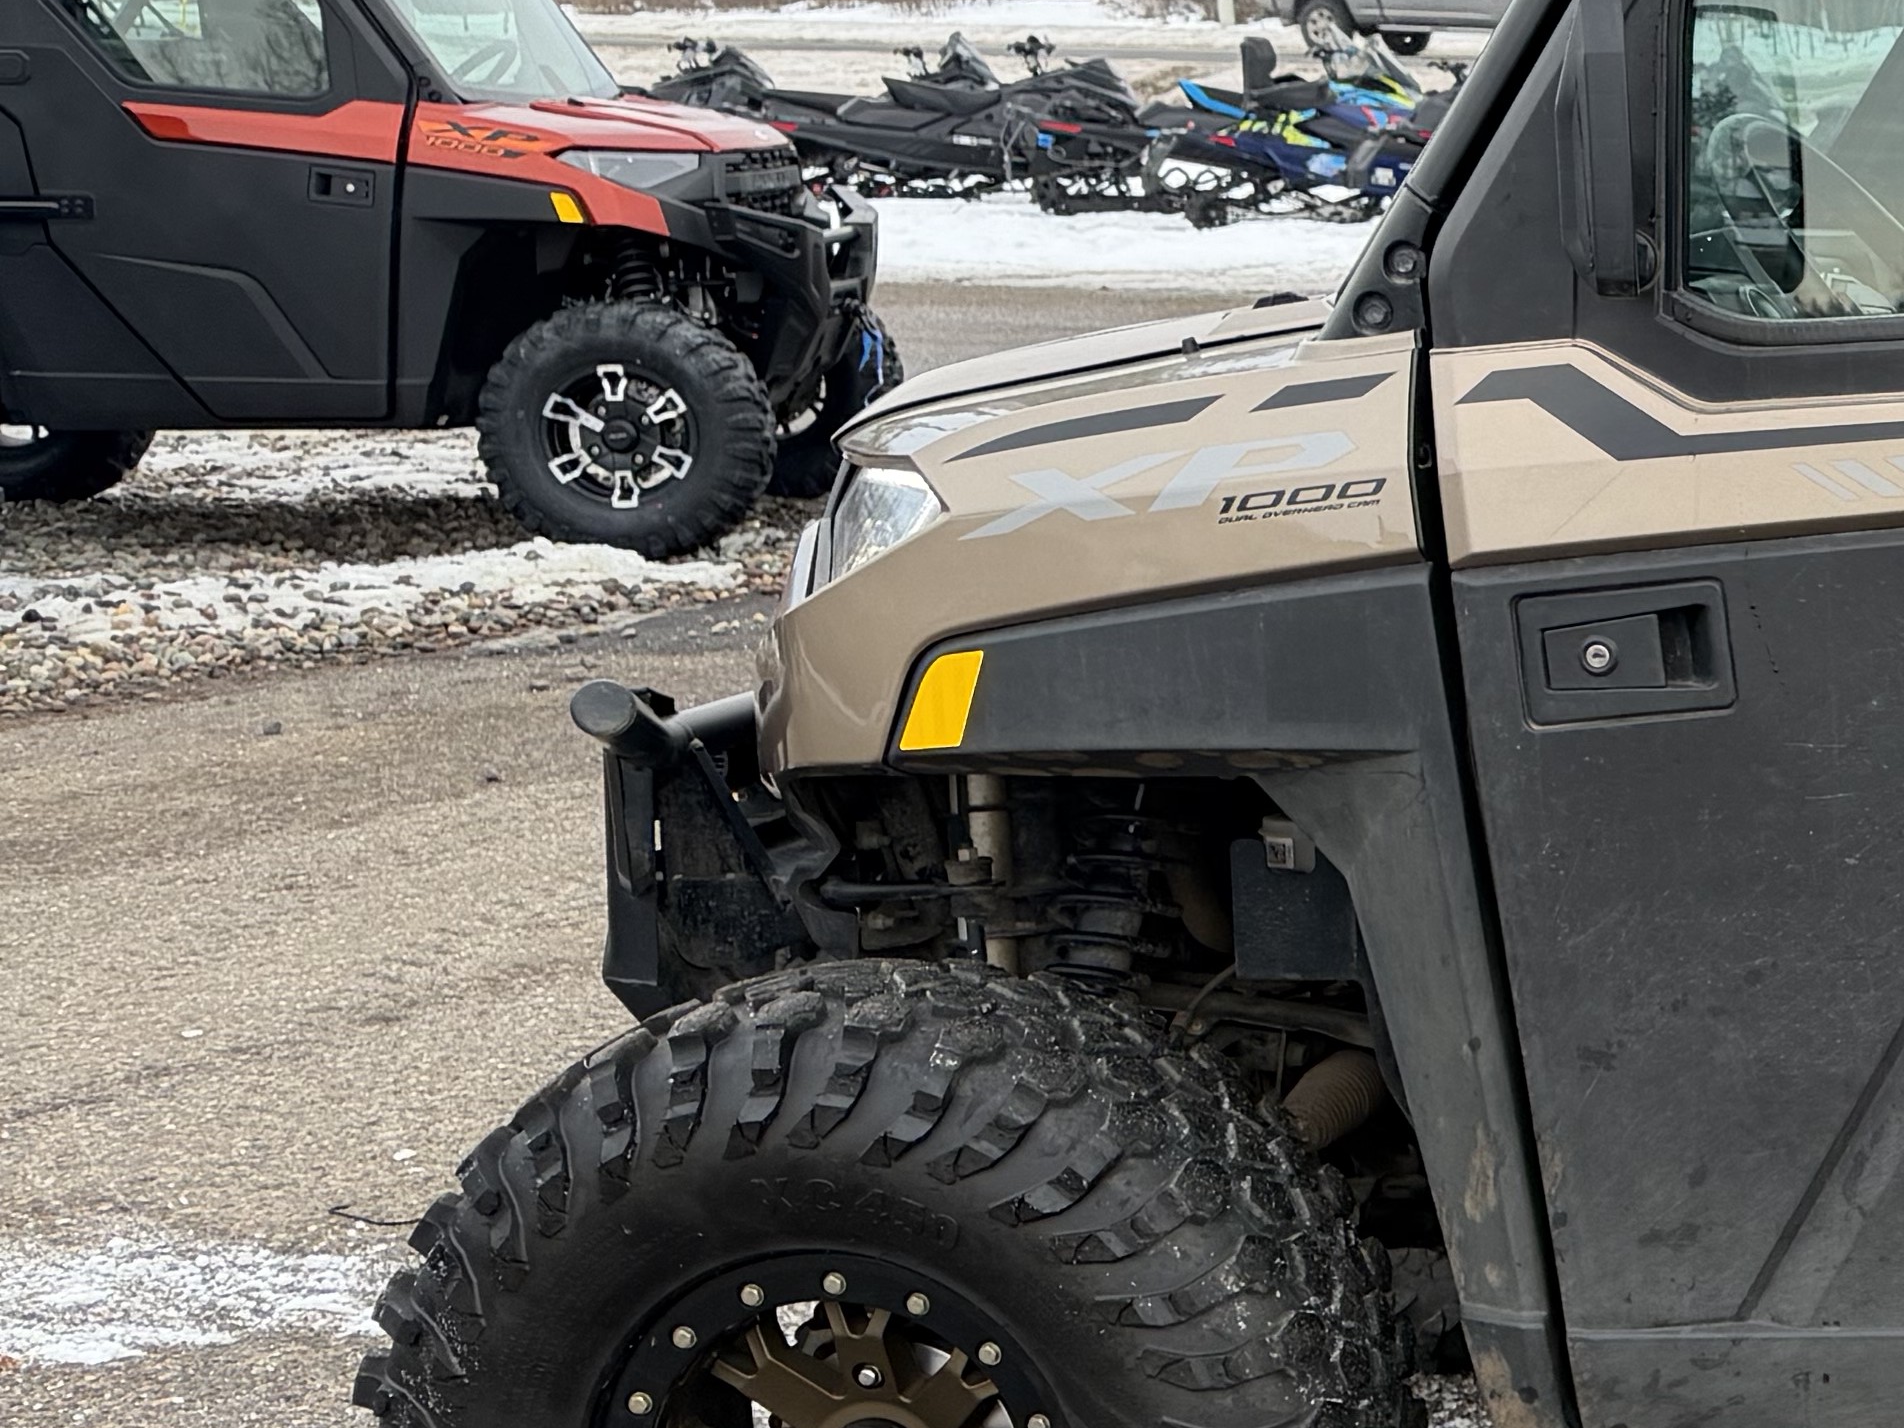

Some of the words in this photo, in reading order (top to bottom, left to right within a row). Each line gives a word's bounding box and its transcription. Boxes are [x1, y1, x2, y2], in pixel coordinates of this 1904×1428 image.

[435, 120, 540, 142] XP
[425, 135, 505, 157] 1000
[959, 430, 1357, 541] XP
[1219, 477, 1388, 515] 1000
[1217, 513, 1258, 525] DUAL
[1262, 502, 1345, 520] OVERHEAD
[1346, 498, 1382, 510] CAM
